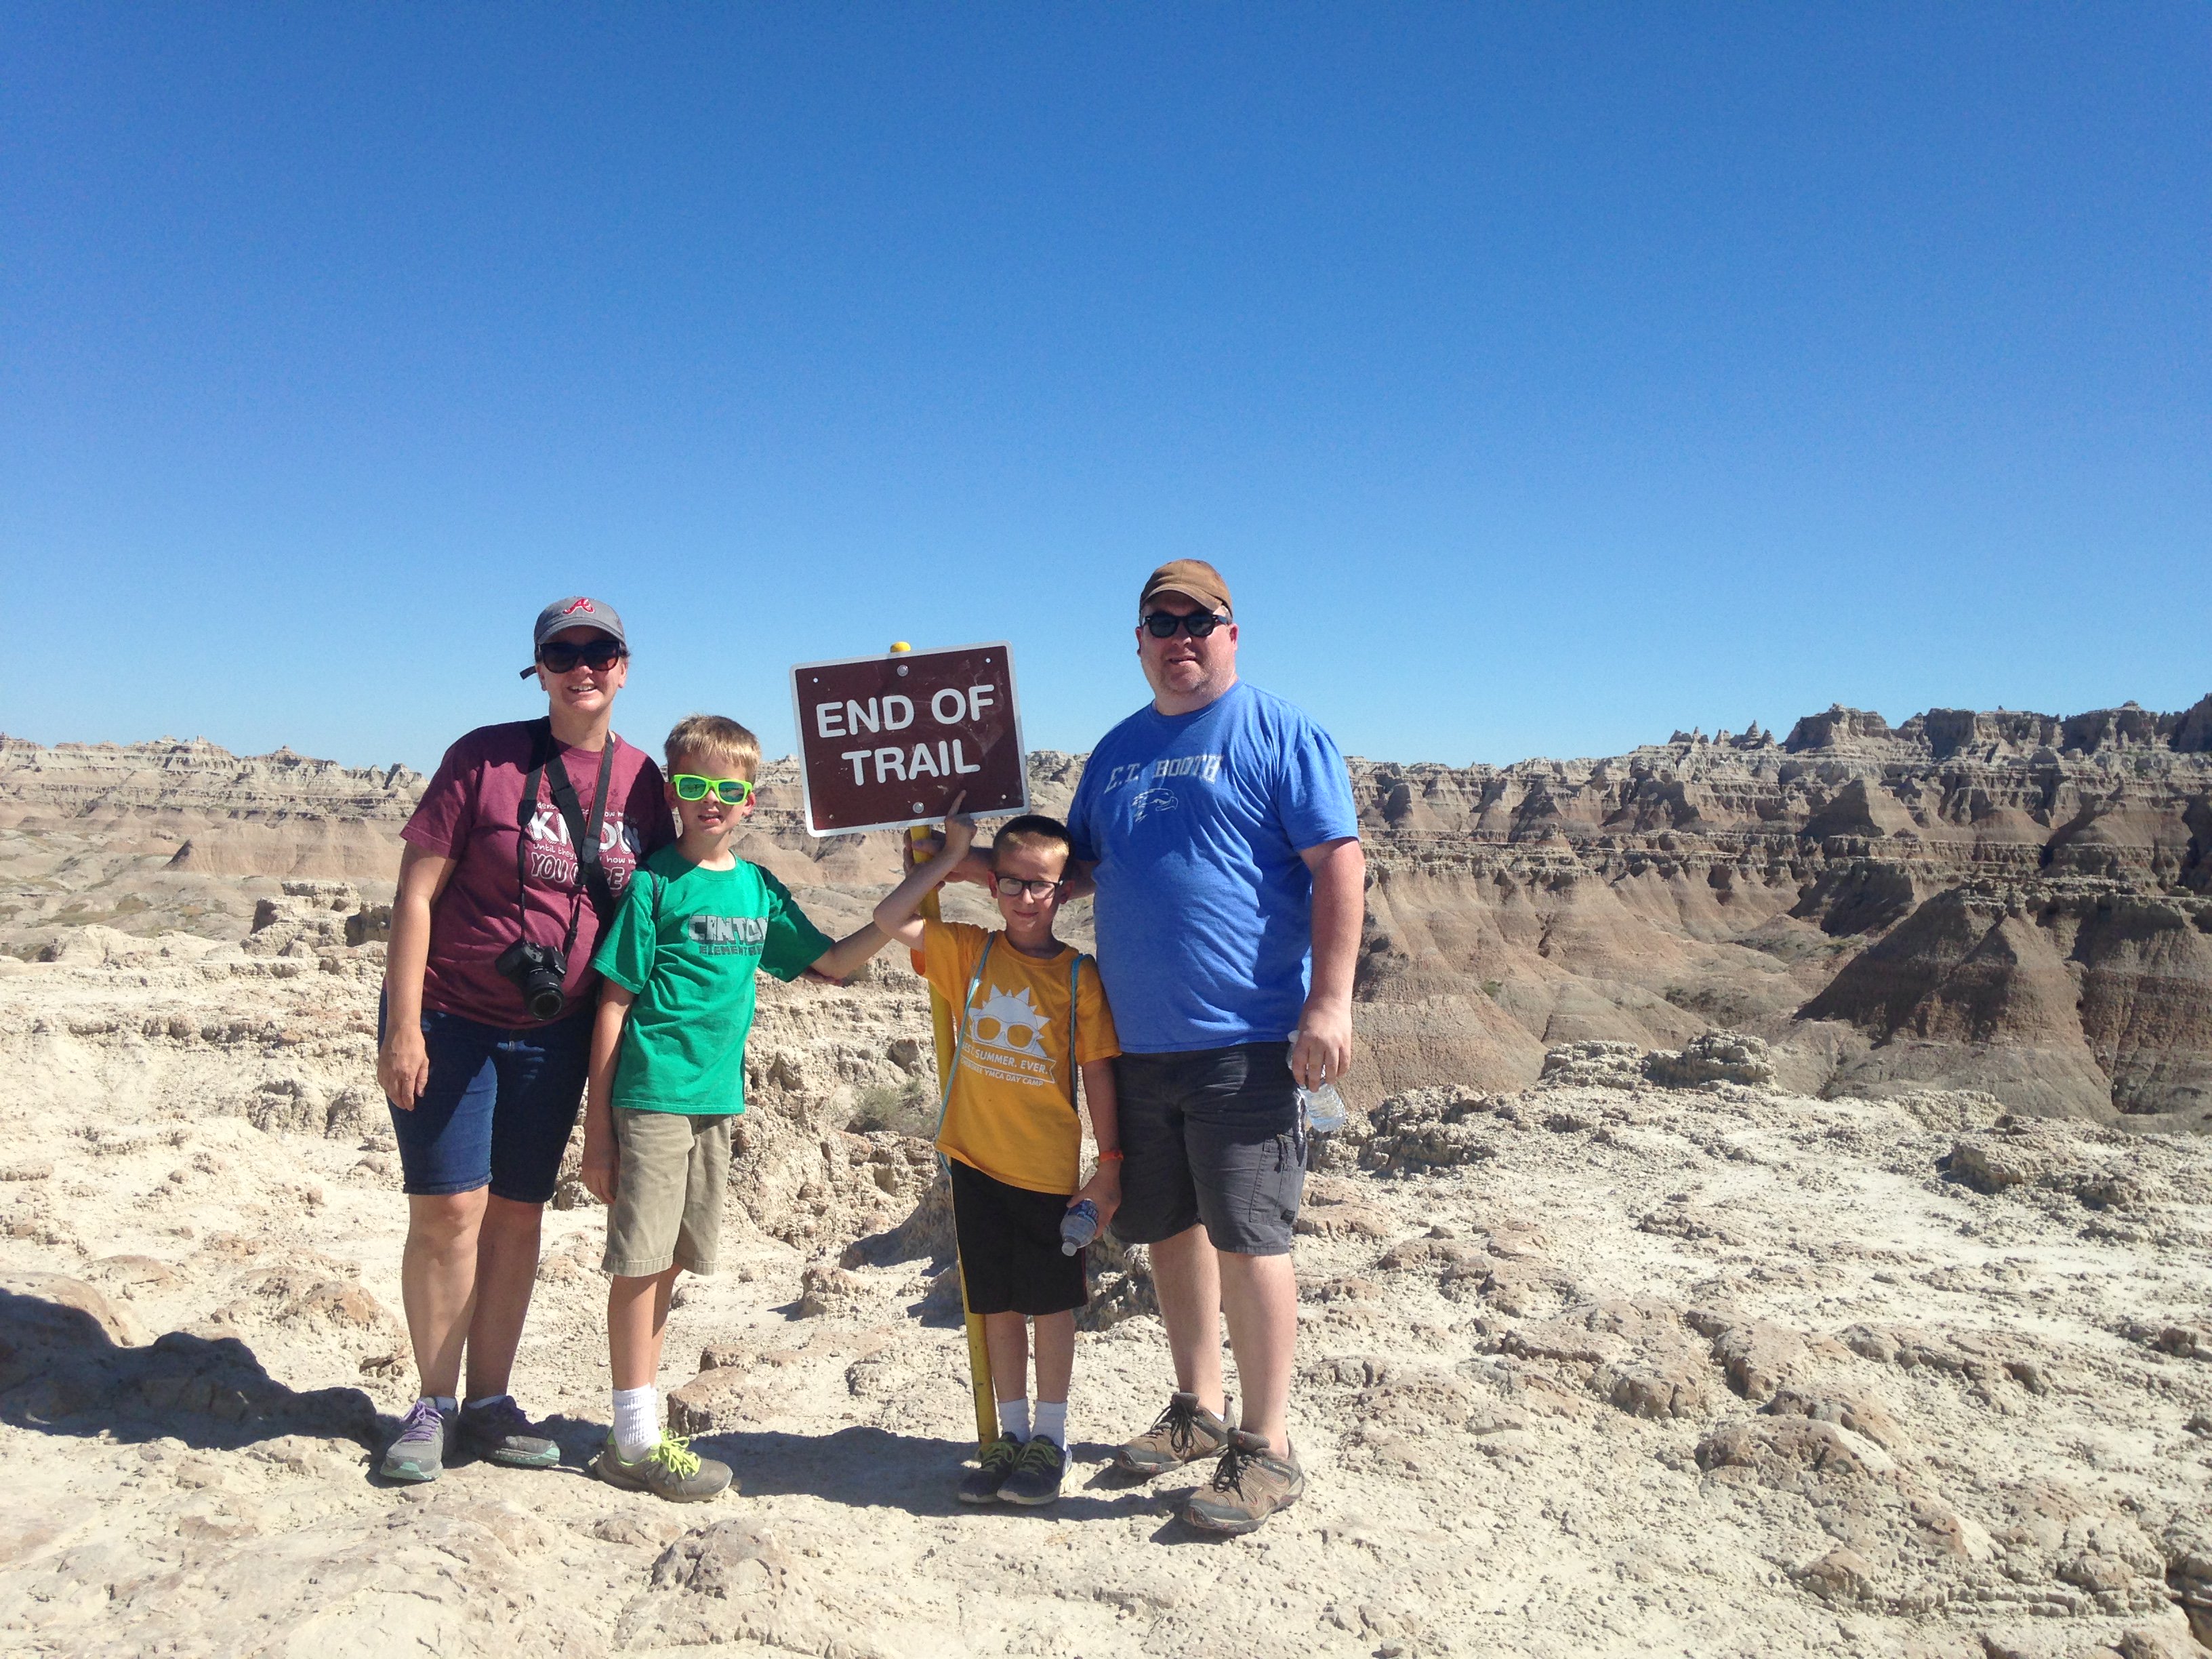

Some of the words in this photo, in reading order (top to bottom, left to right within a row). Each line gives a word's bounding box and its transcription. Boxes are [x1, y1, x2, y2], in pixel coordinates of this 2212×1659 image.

[816, 695, 915, 738] END
[931, 684, 995, 724] OF
[842, 739, 981, 786] TRAIL
[1154, 754, 1224, 784] BOOTH
[531, 852, 569, 884] YOU
[558, 847, 574, 860] they
[607, 855, 626, 863] how
[975, 1049, 1017, 1067] SUMMER.
[1021, 1060, 1048, 1074] EVER.
[985, 1068, 1004, 1080] YMCA
[1006, 1074, 1022, 1083] DAY
[1023, 1078, 1044, 1088] CAMP
